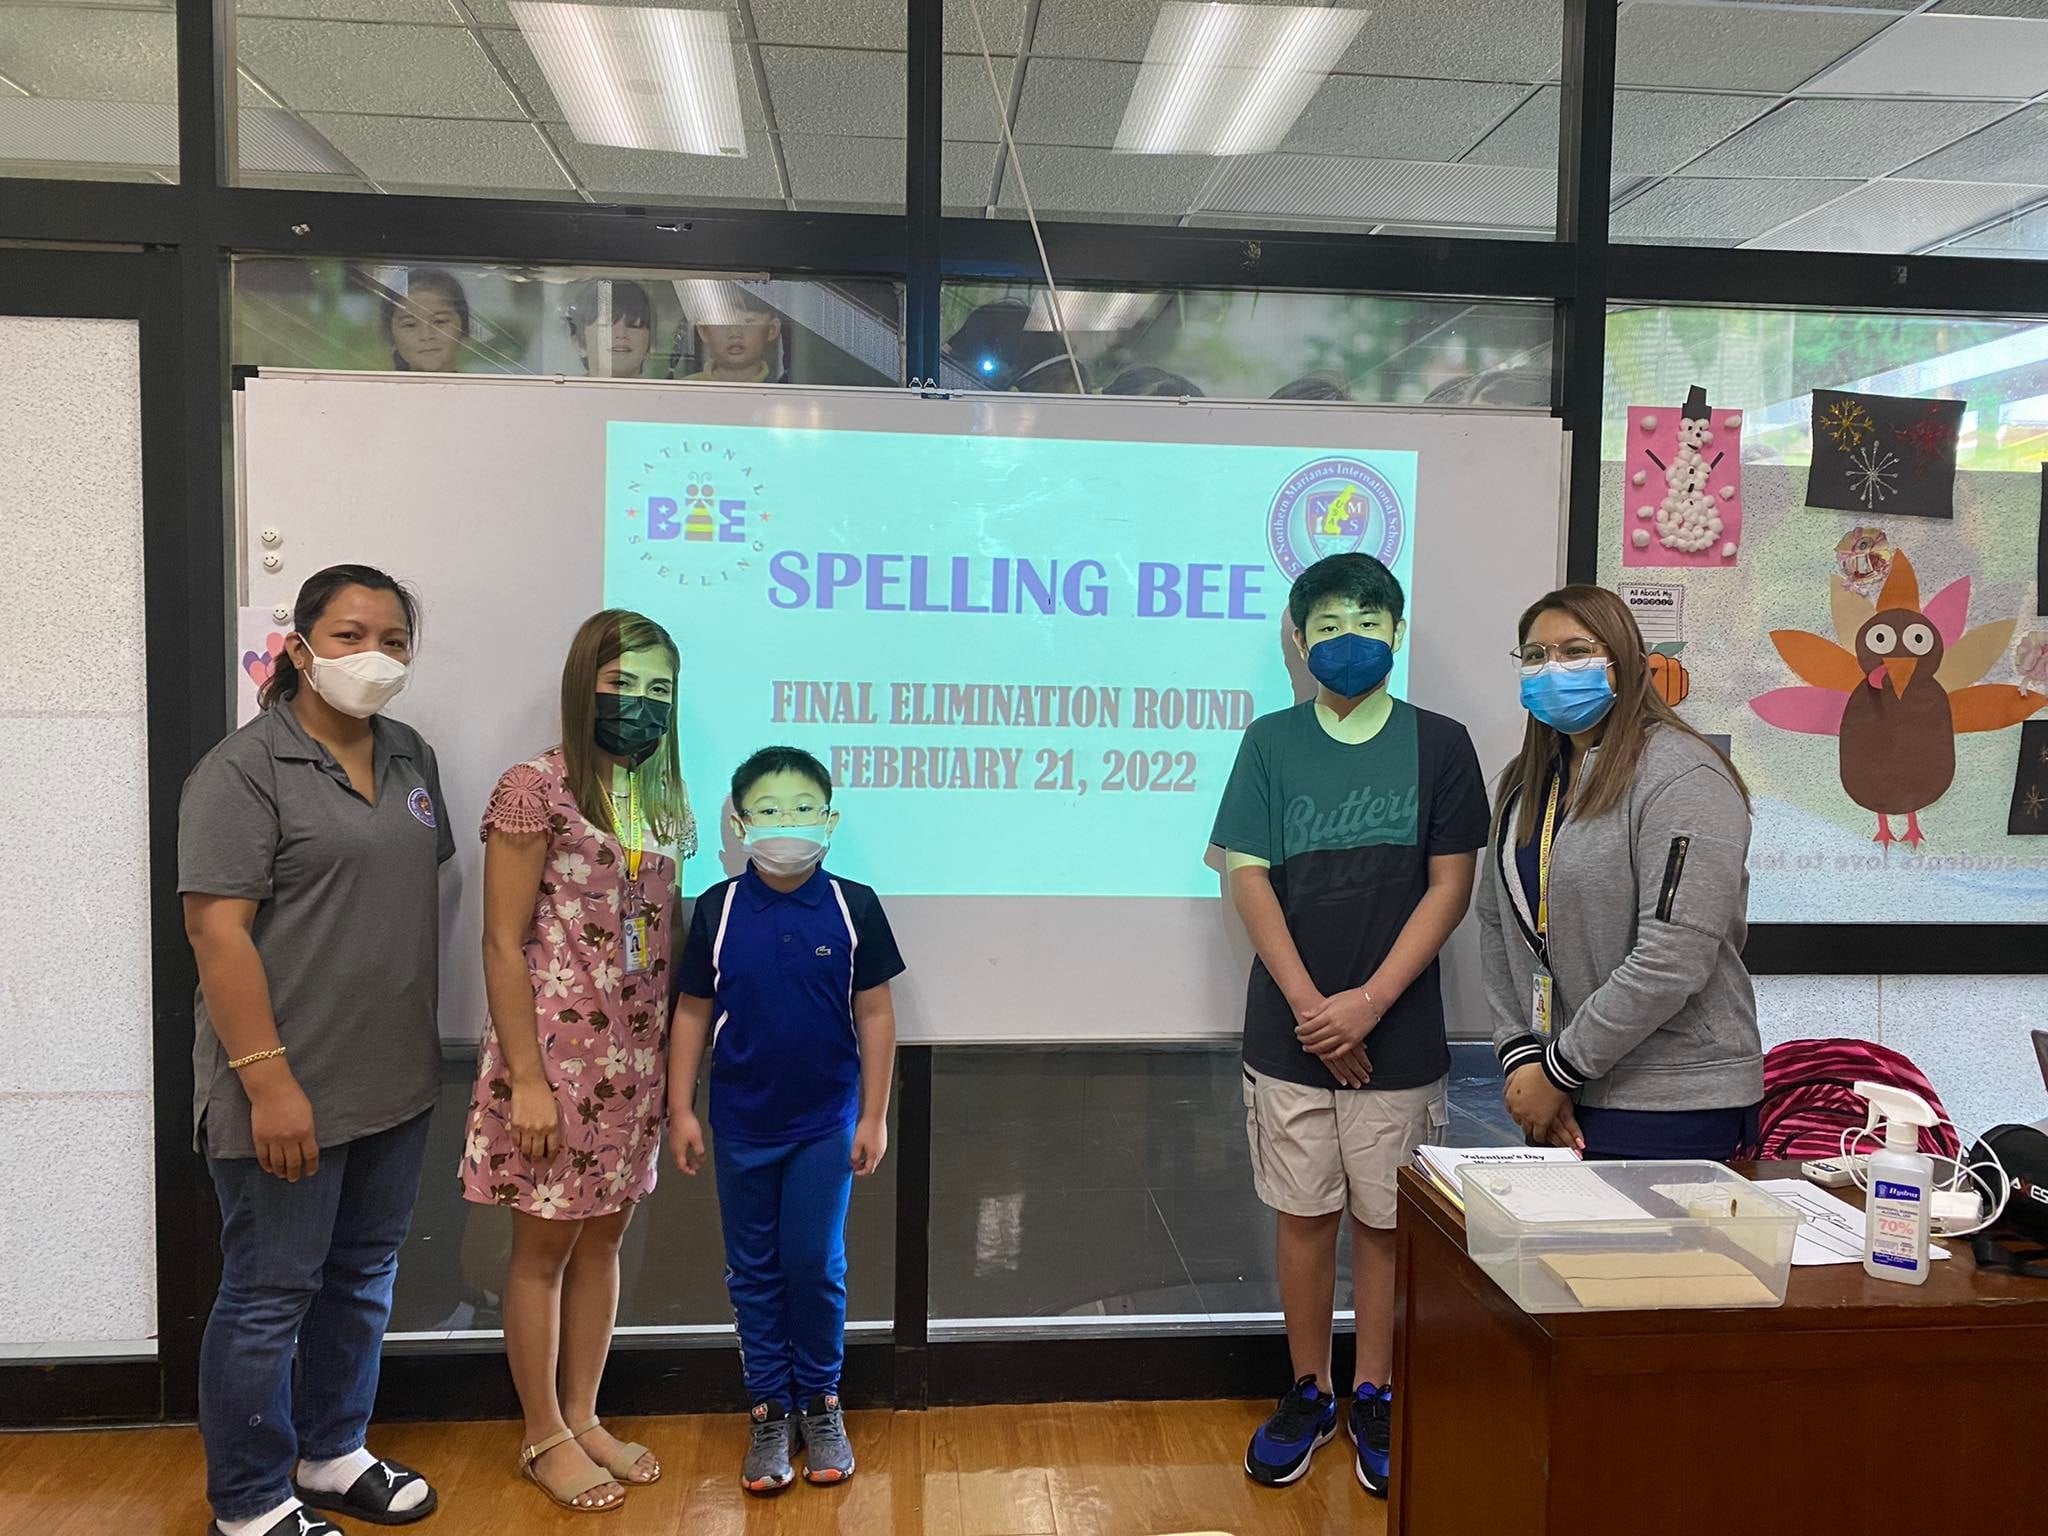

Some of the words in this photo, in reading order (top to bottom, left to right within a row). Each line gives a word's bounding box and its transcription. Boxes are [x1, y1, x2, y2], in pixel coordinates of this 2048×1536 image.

[628, 441, 764, 495] NATIONAL
[1273, 501, 1290, 554] Northern
[1284, 465, 1334, 499] Marianas
[1337, 463, 1397, 513] International
[1383, 513, 1398, 560] School
[628, 534, 764, 586] SPELLING
[768, 550, 1108, 617] SPELLING
[1137, 561, 1266, 621] BEE
[1640, 588, 1661, 597] About
[1663, 590, 1673, 599] My
[770, 680, 878, 723] FINAL
[889, 682, 1121, 729] ELIMINATION
[1132, 687, 1255, 731] ROUND
[829, 745, 1024, 790] FEBRUARY
[1034, 749, 1088, 796] 21,
[1101, 750, 1198, 793] 2022
[1878, 1218, 1913, 1234] 70%
